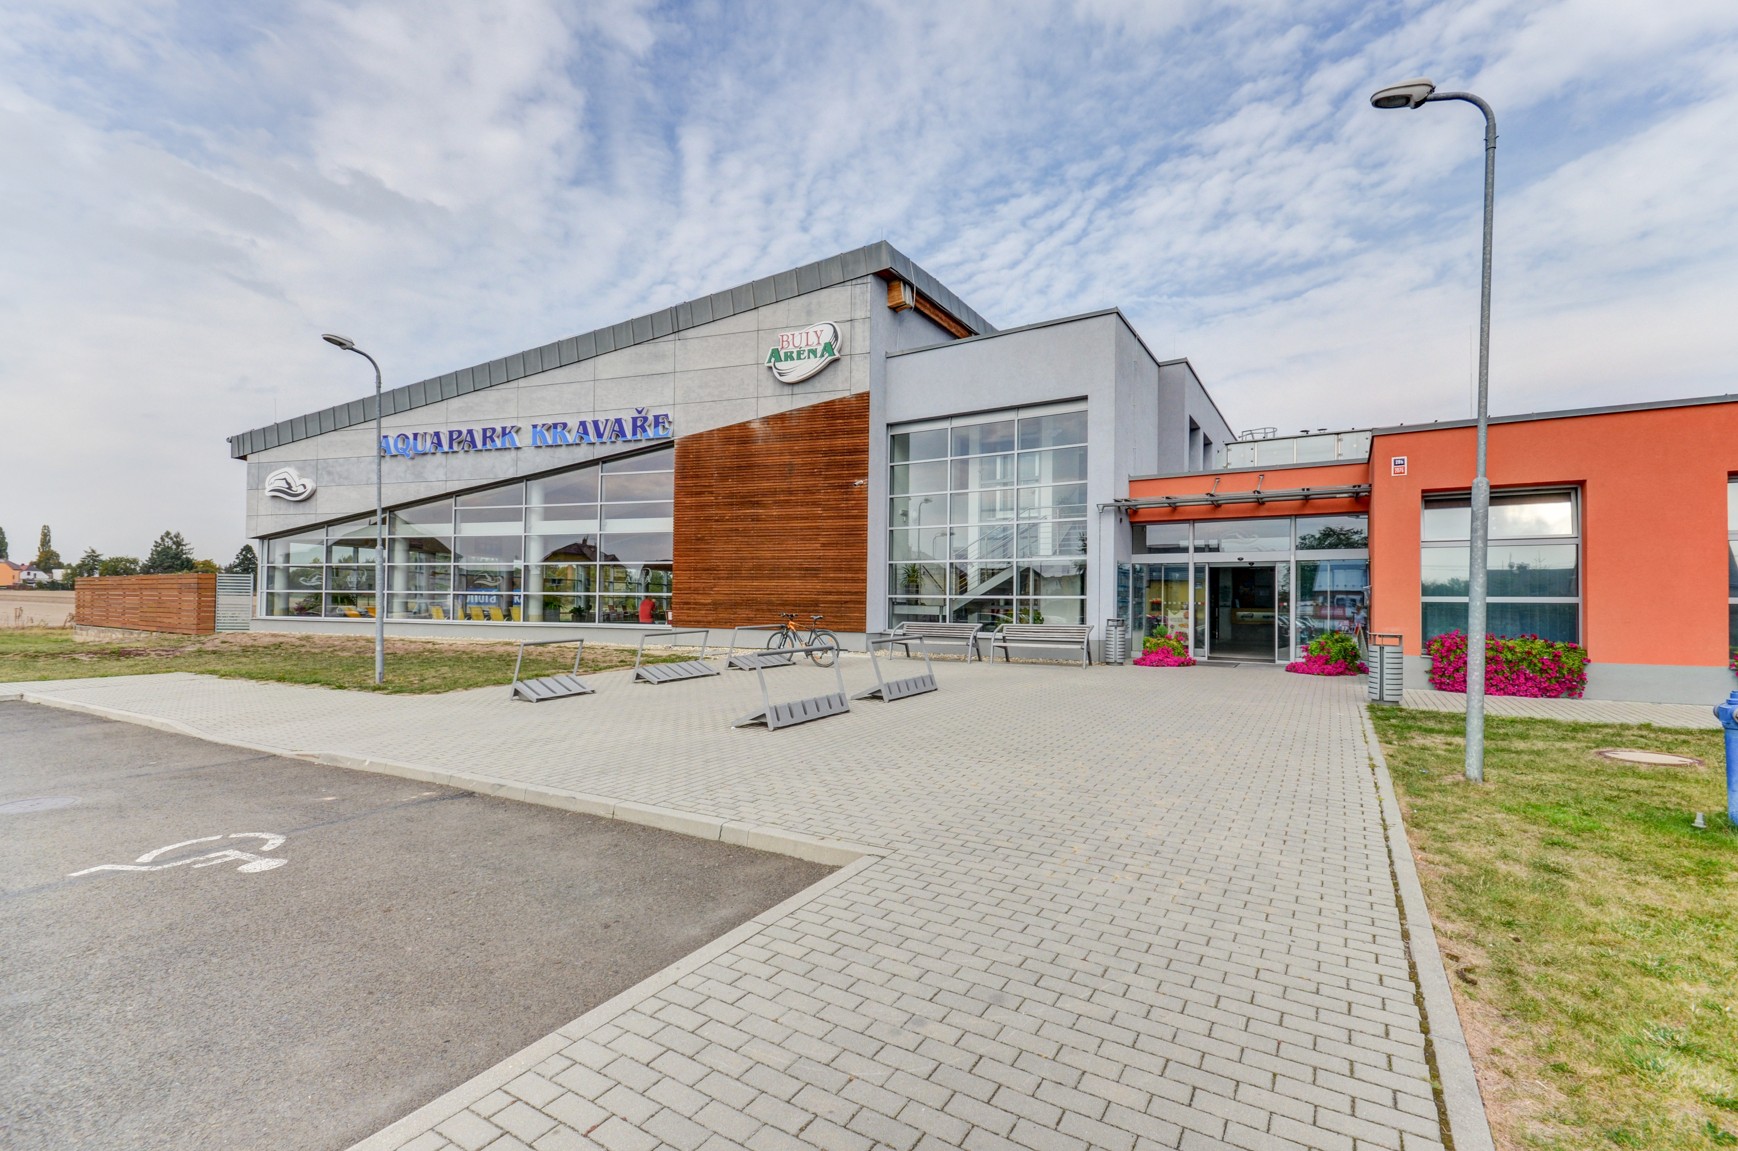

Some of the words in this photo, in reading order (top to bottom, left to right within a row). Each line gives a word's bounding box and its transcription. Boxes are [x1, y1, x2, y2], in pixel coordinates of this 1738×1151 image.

[780, 330, 824, 350] BULY
[381, 425, 518, 459] AQUAPARK
[531, 407, 671, 447] KRAVAŘE
